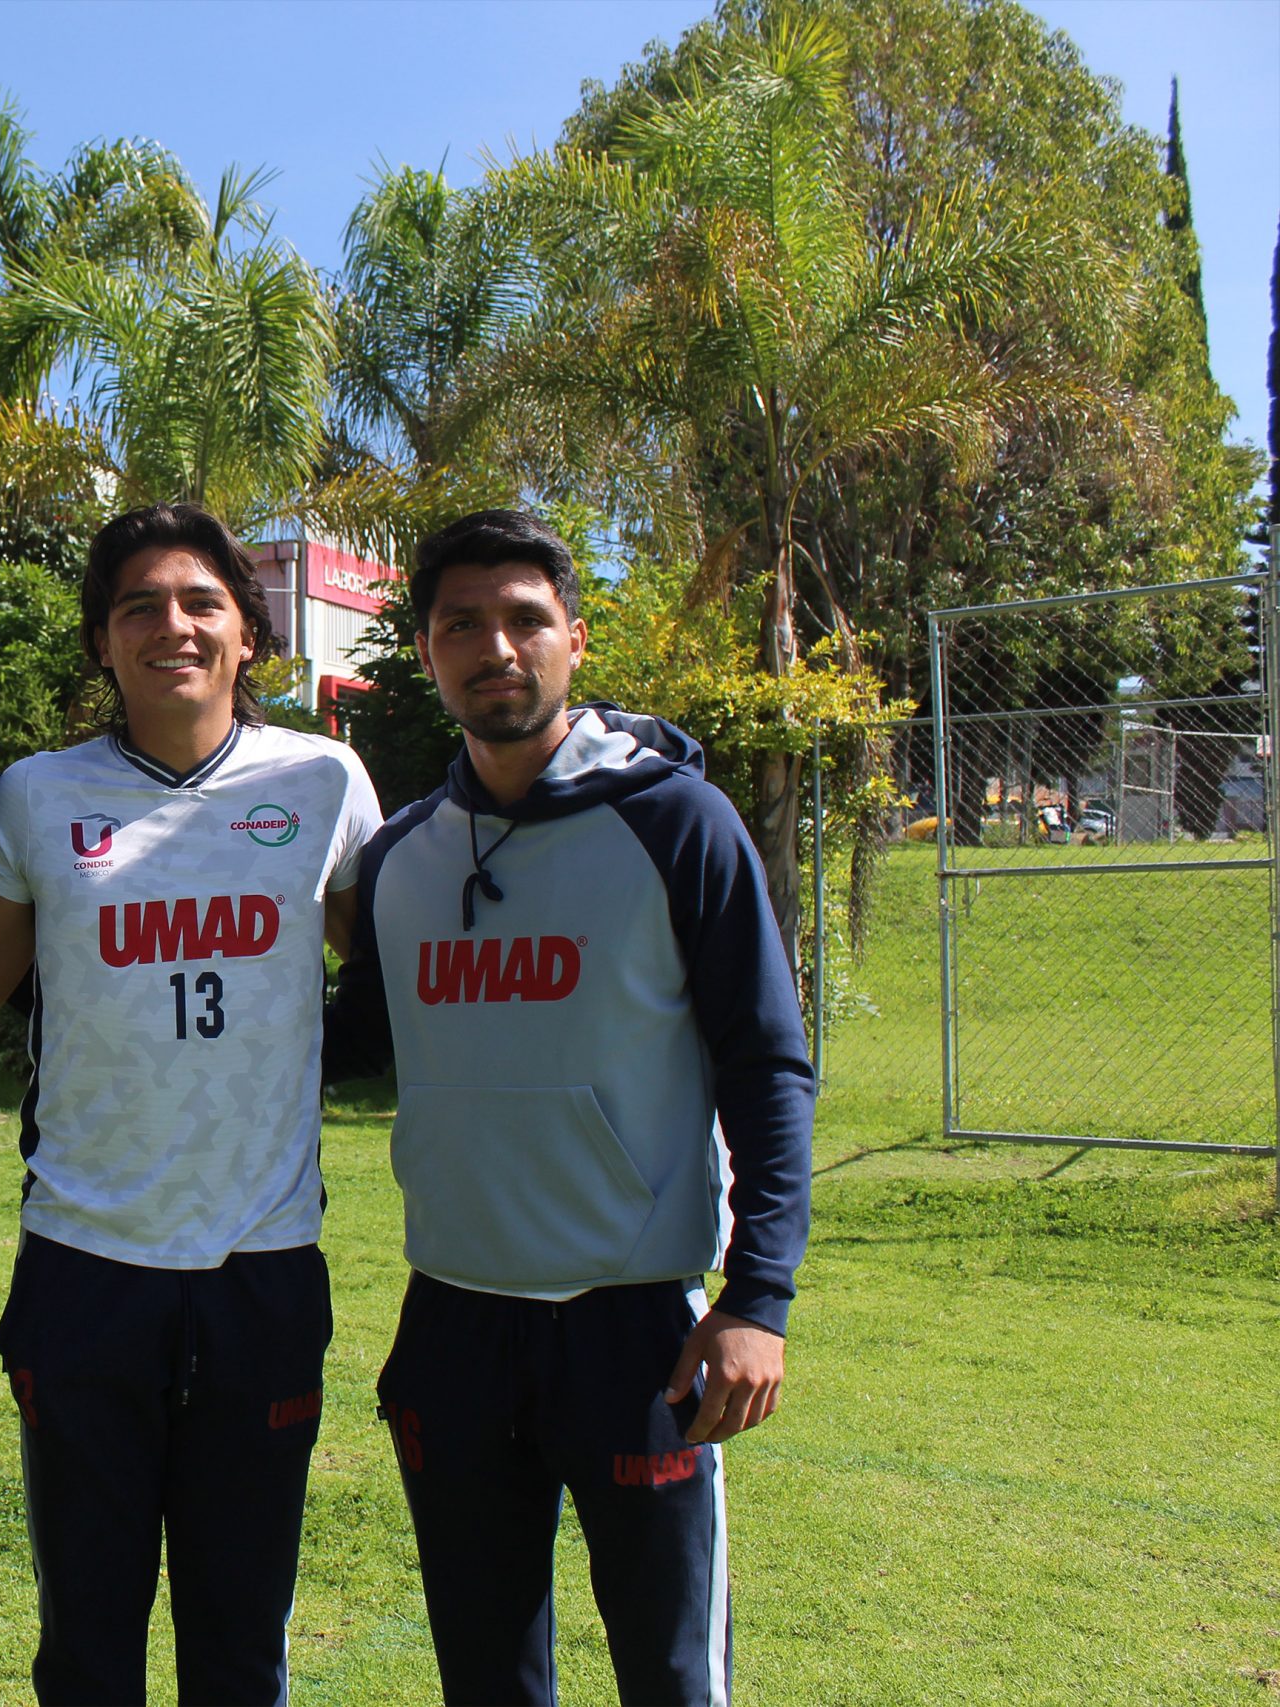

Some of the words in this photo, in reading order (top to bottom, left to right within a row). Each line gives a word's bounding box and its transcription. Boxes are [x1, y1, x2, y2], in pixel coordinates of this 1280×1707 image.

[230, 820, 288, 830] CONADEIP
[73, 860, 114, 871] CONDDE
[79, 869, 110, 879] MÉXICO
[169, 971, 225, 1040] 13
